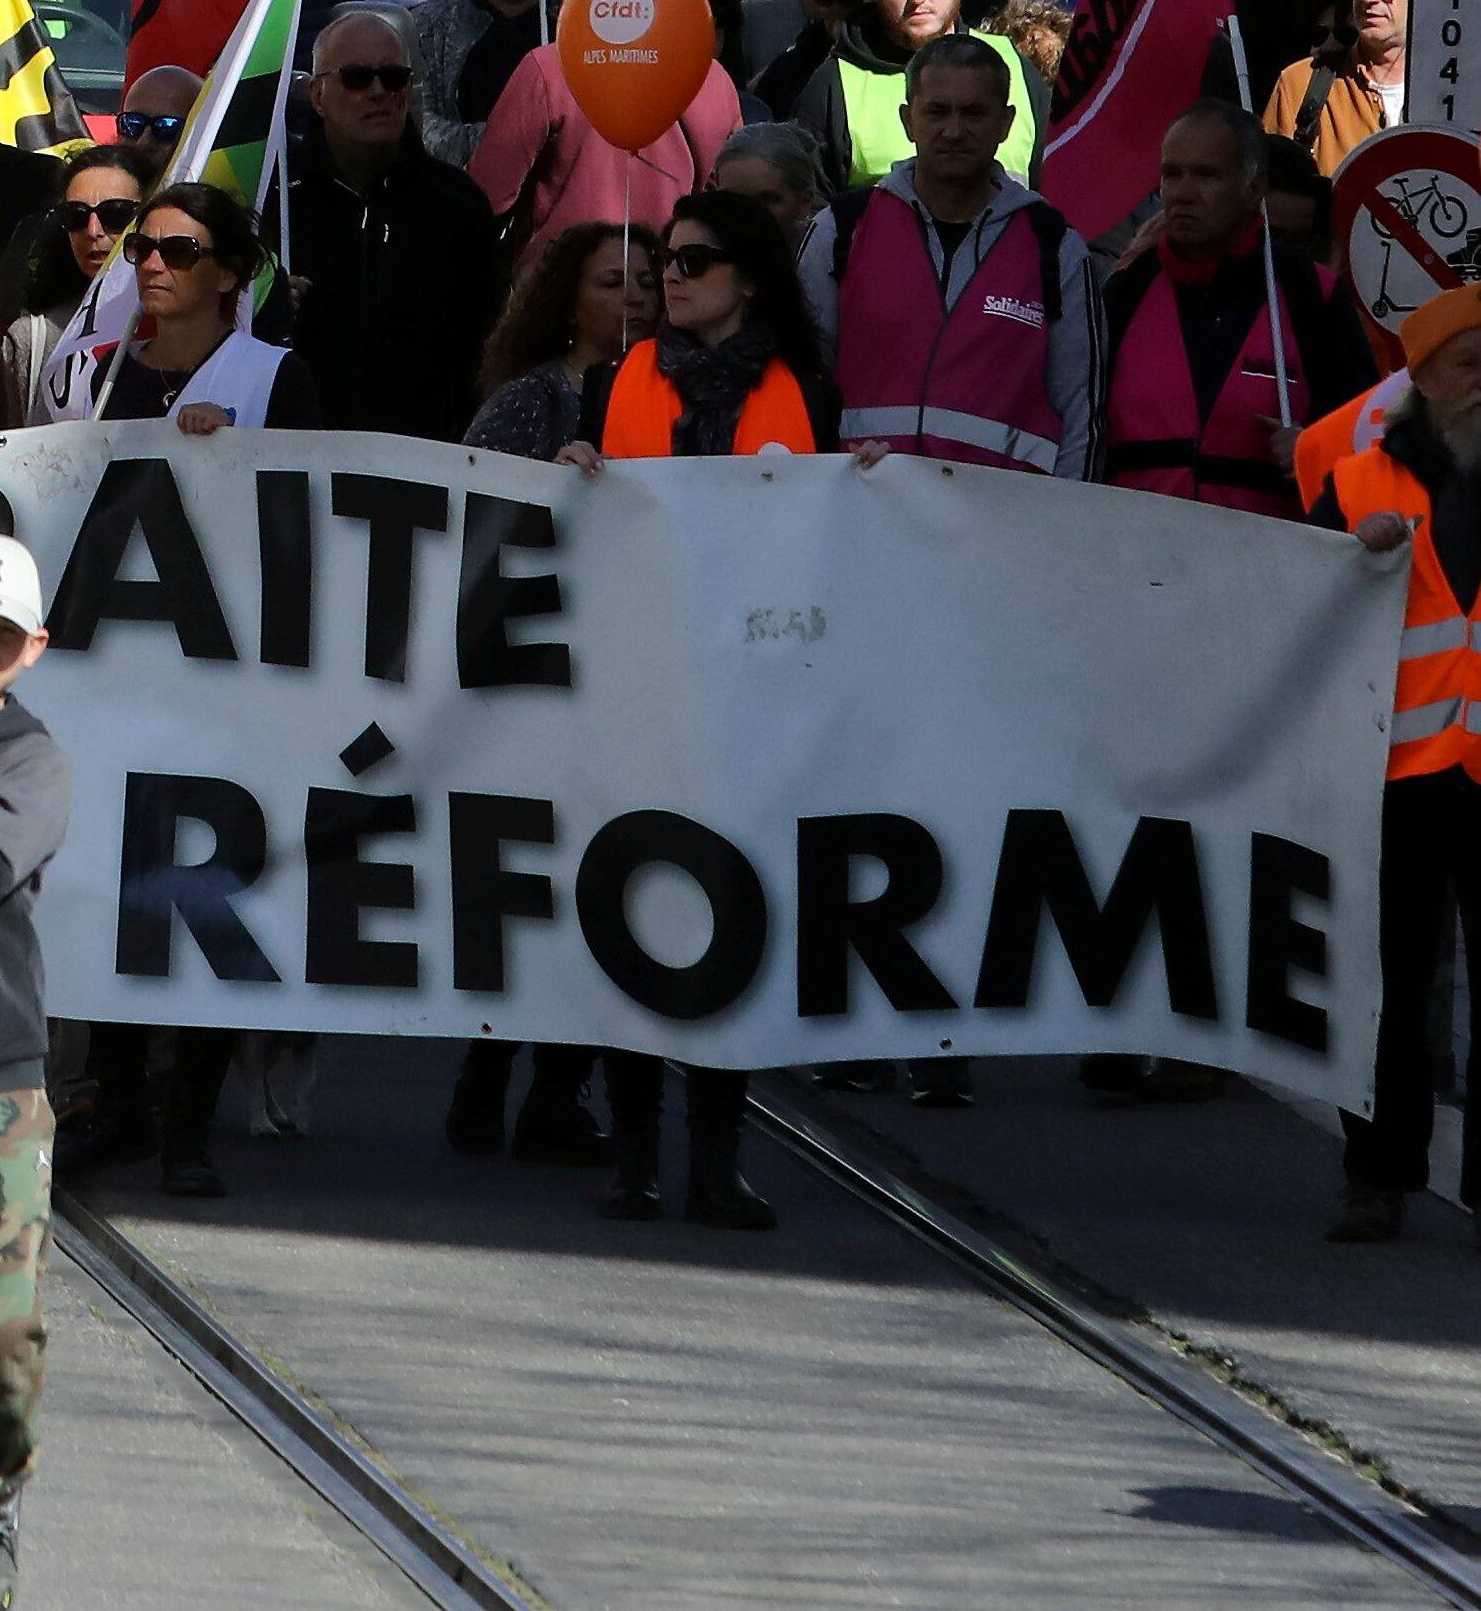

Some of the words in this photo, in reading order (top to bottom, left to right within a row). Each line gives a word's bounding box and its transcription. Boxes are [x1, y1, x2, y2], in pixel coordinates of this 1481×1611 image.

[594, 1, 649, 19] Cfdt:
[583, 50, 607, 65] ALPES
[609, 49, 658, 65] MARITIMES
[983, 295, 1045, 325] Solidaires
[115, 720, 1331, 1054] RÉFORME
